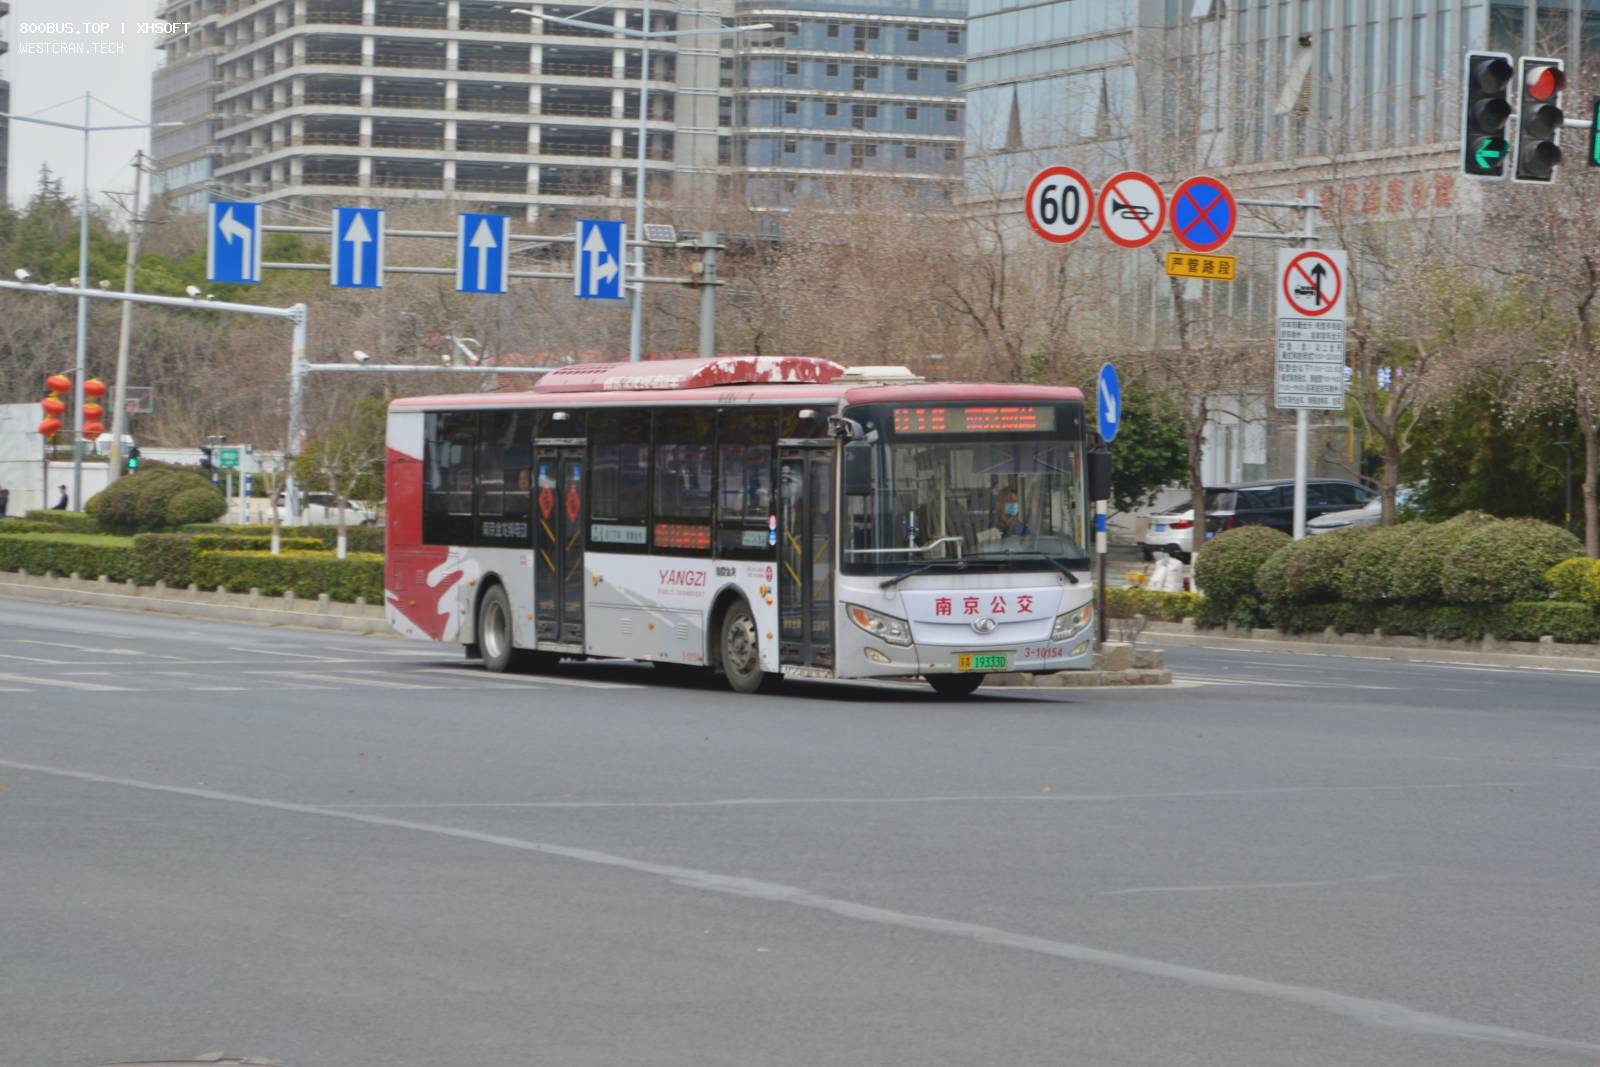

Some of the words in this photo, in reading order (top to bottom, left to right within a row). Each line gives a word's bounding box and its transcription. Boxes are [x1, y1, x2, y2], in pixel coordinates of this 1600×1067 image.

[1040, 184, 1080, 226] 60
[659, 569, 707, 587] YANGZI
[935, 594, 1033, 616] 南京公交
[1024, 647, 1063, 658] 3-10154
